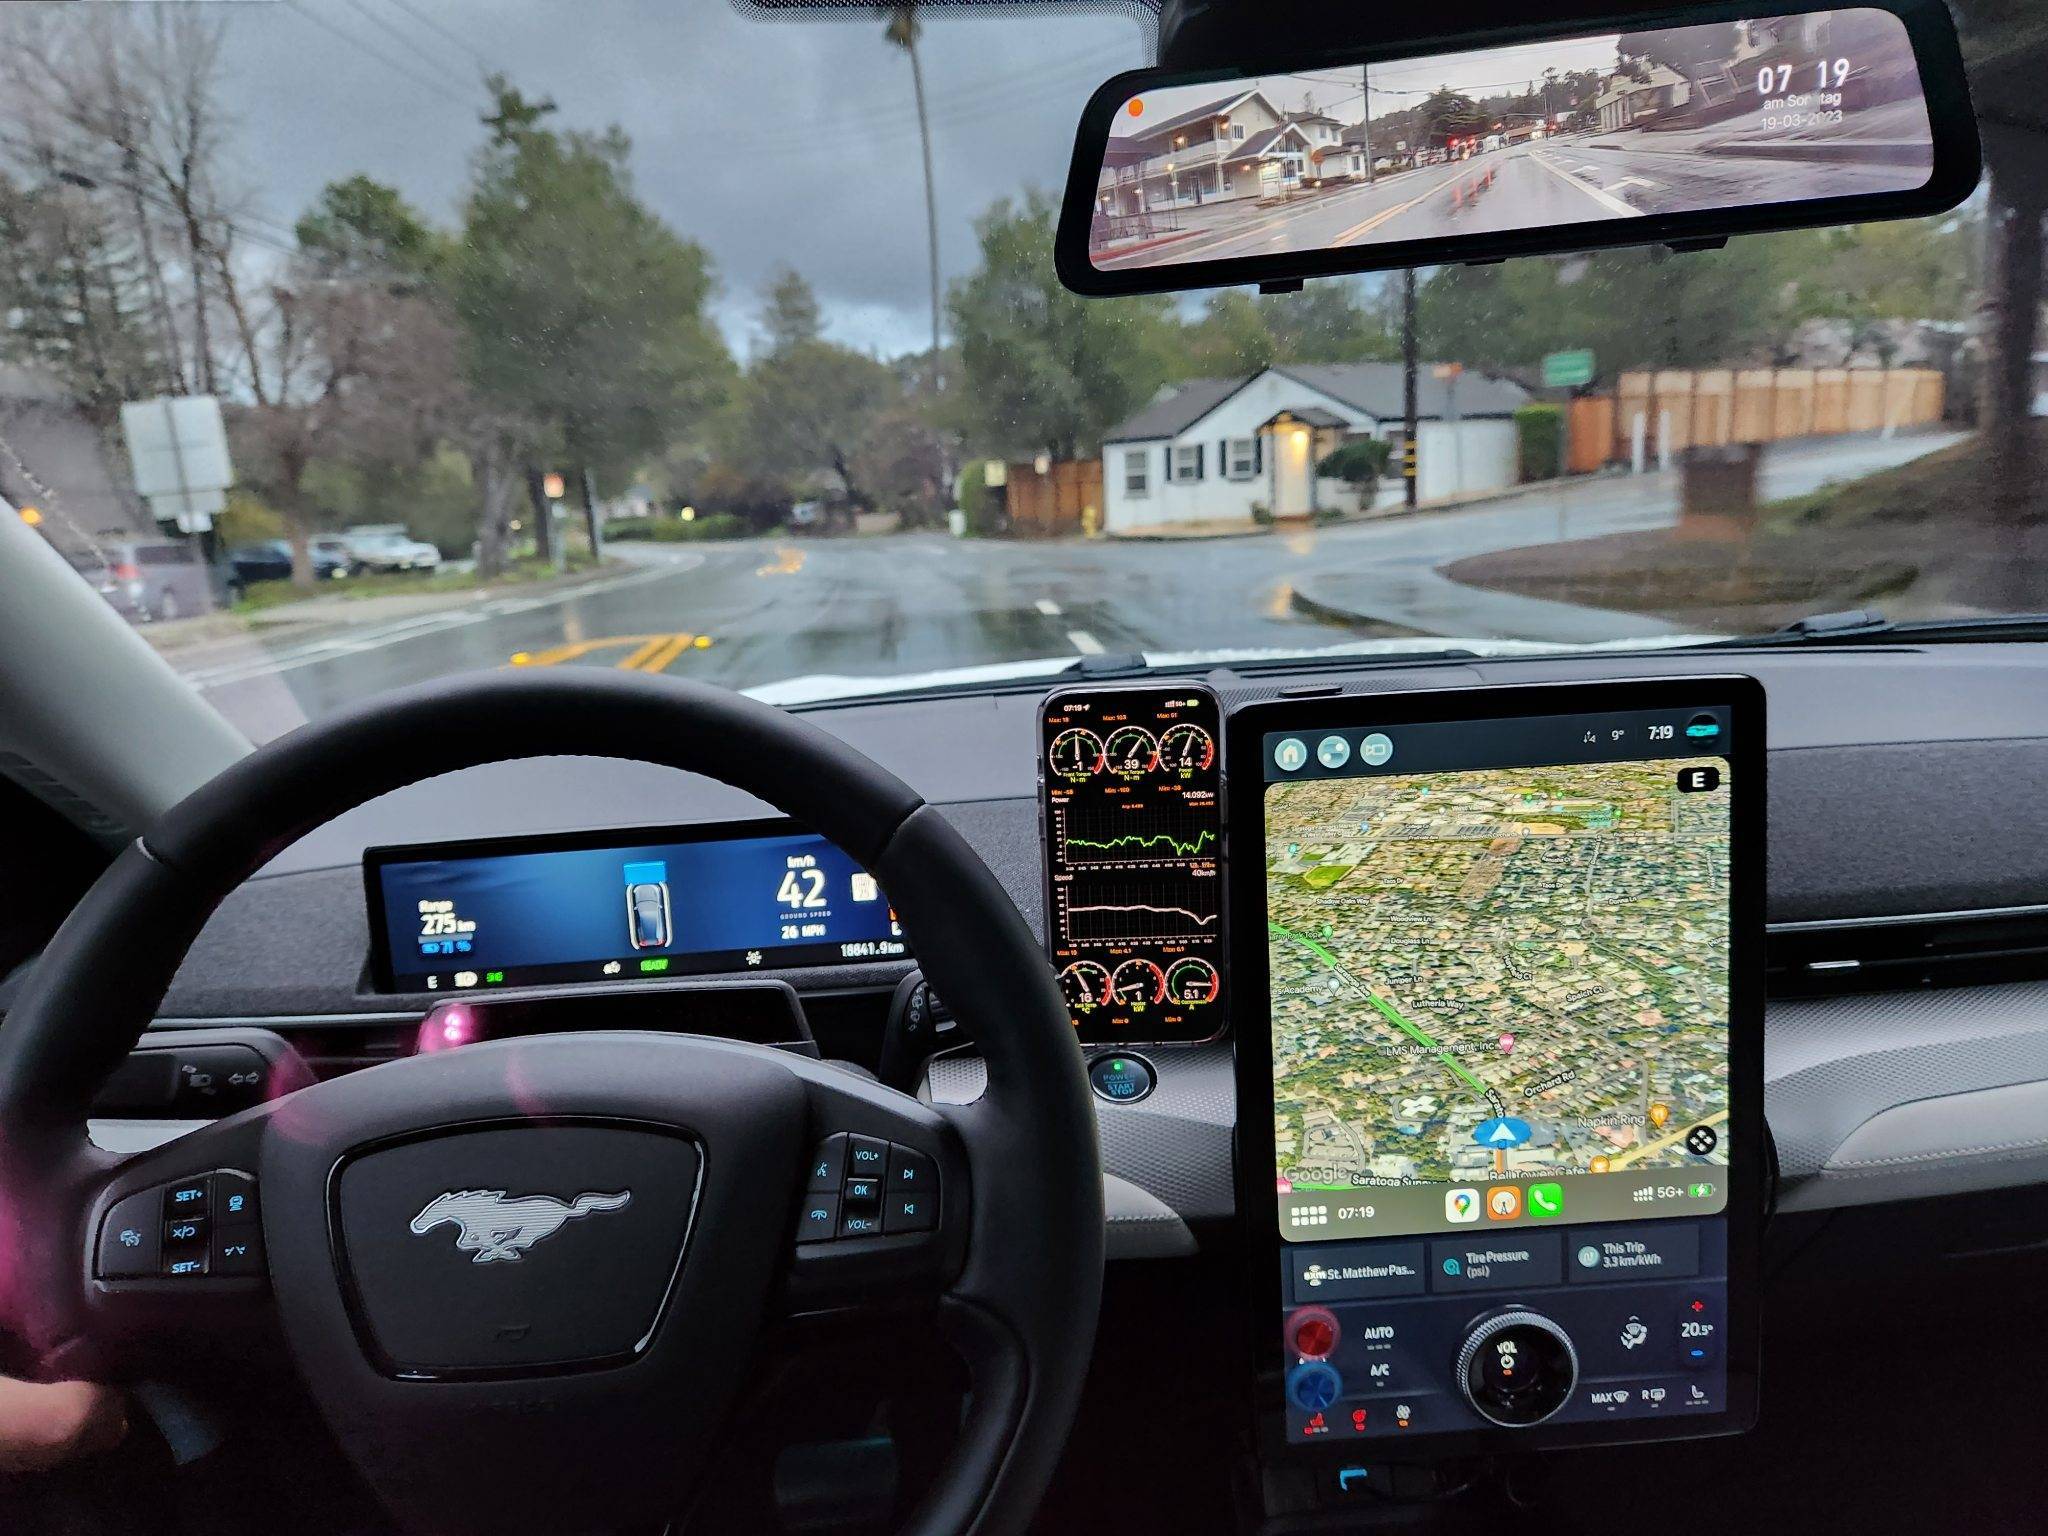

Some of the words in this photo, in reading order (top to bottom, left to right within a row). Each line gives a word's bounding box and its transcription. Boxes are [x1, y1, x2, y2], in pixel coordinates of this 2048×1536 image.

[1758, 64, 1792, 94] 07
[1818, 58, 1850, 88] 19
[1764, 98, 1784, 110] am
[1611, 729, 1624, 740] 9°
[1648, 725, 1674, 740] 7:19
[1072, 761, 1083, 771] -1
[1124, 759, 1139, 770] 39
[1178, 756, 1193, 767] 14
[1692, 772, 1705, 787] E
[787, 855, 816, 868] km/h
[777, 869, 828, 909] 42
[420, 912, 457, 935] 275
[781, 925, 799, 939] 26
[801, 924, 826, 937] MPH
[1385, 977, 1413, 985] Juniper
[1135, 991, 1142, 1001] 1
[1184, 989, 1199, 999] 5.1
[1284, 985, 1323, 995] Academy
[1079, 993, 1093, 1002] 16
[1446, 1001, 1464, 1010] Way
[1386, 1046, 1408, 1056] LMS
[1480, 1042, 1495, 1050] Inc
[1524, 1077, 1562, 1097] Orchard
[1562, 1070, 1576, 1082] Rd
[1578, 1115, 1619, 1128] Napkin
[1620, 1114, 1646, 1126] Ring
[1283, 1164, 1348, 1185] Google
[854, 1184, 868, 1196] OK
[1657, 1187, 1684, 1199] 5G+
[1338, 1206, 1375, 1220] 07:19
[1603, 1243, 1624, 1254] This
[1625, 1242, 1646, 1254] Trip
[1466, 1252, 1486, 1264] Tire
[1486, 1251, 1530, 1262] Pressure
[1603, 1257, 1619, 1268] 3.3
[1619, 1255, 1662, 1267] km/kWh
[1328, 1269, 1342, 1280] St.
[1343, 1266, 1388, 1279] Matthew
[1467, 1265, 1490, 1279] (psi)
[1364, 1326, 1394, 1340] AUTO
[1496, 1341, 1518, 1355] VOL
[1370, 1364, 1390, 1377] A/C
[1591, 1393, 1612, 1404] MAX
[1641, 1390, 1648, 1400] R
